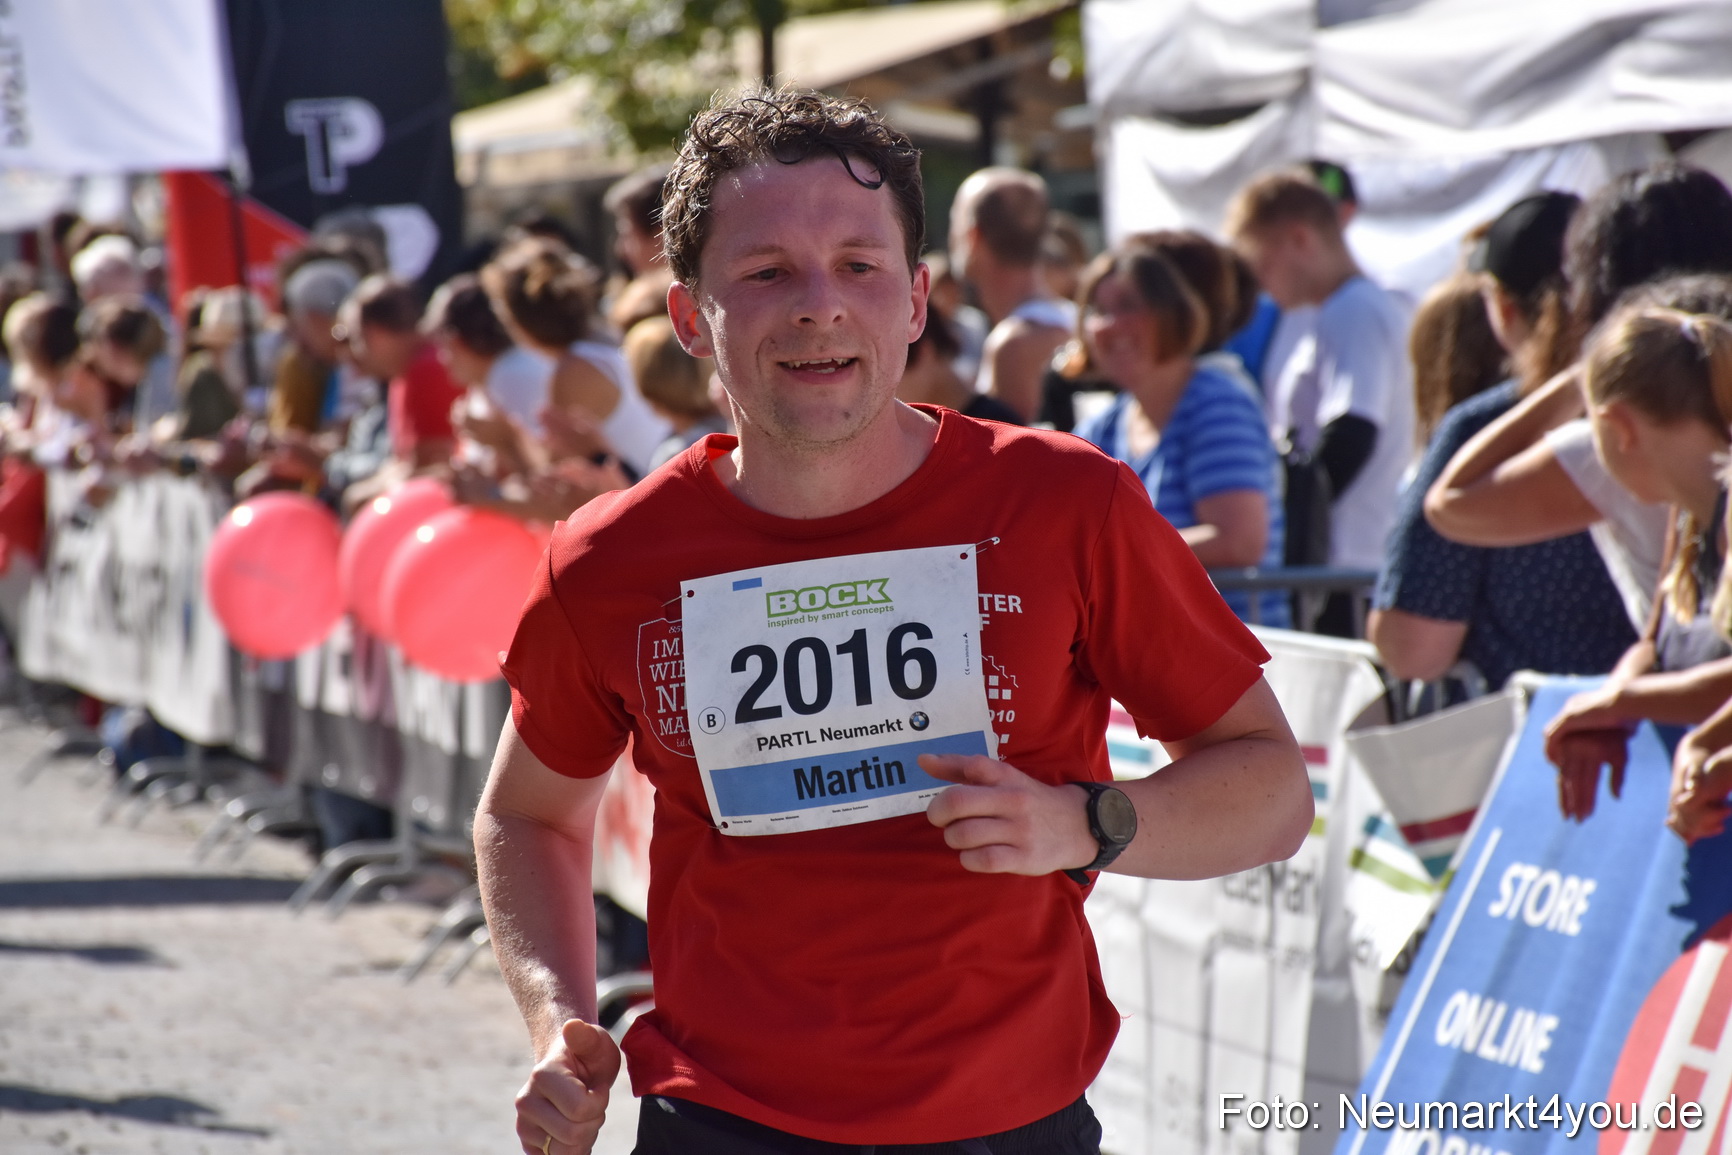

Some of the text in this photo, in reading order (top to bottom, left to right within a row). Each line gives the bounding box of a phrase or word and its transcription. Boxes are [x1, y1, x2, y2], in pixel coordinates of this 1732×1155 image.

[766, 578, 893, 618] BOCK
[768, 605, 895, 628] inspired by smart concepts
[731, 622, 938, 725] 2016
[706, 713, 717, 728] B
[757, 718, 904, 751] PARTL Neumarkt
[793, 756, 907, 801] Martin
[1488, 862, 1598, 936] STORE
[1435, 989, 1561, 1075] ONLINE
